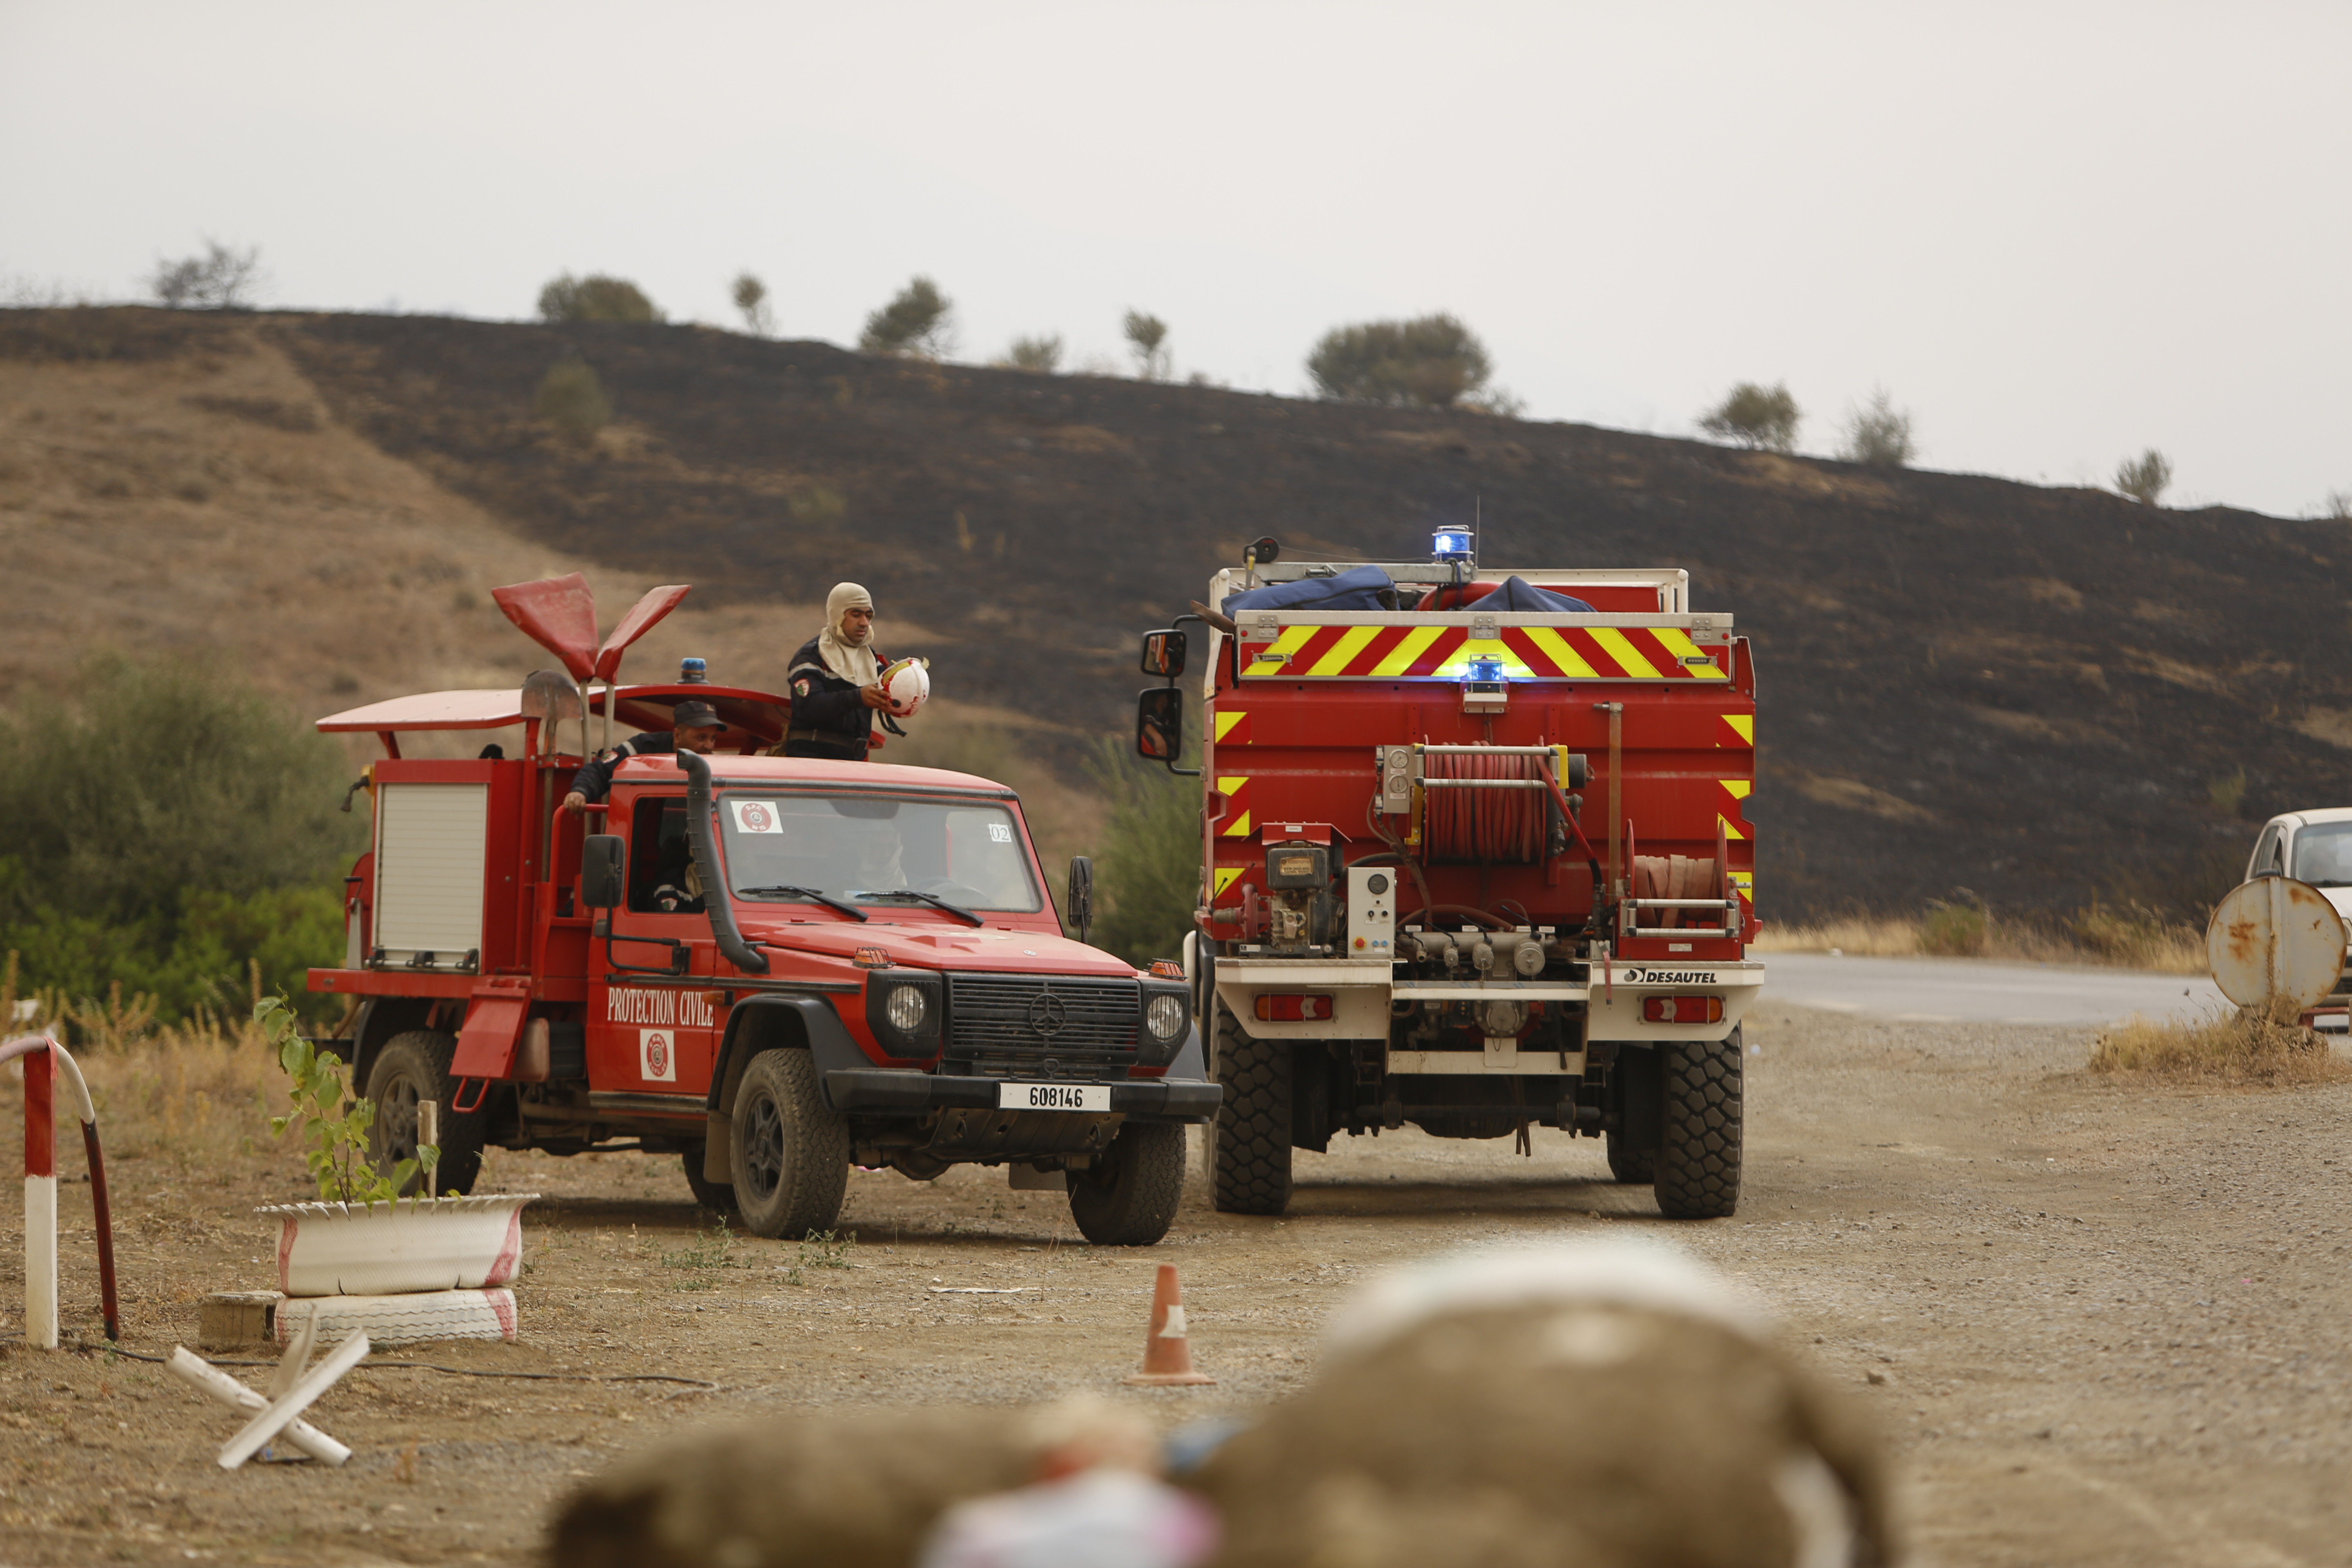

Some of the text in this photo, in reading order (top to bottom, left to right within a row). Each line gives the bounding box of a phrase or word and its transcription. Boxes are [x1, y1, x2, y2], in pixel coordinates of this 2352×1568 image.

[991, 826, 1009, 840] 02
[1646, 972, 1717, 984] DESAUTEL
[607, 987, 714, 1027] PROTECTION CIVILE
[1030, 1087, 1083, 1107] 608146
